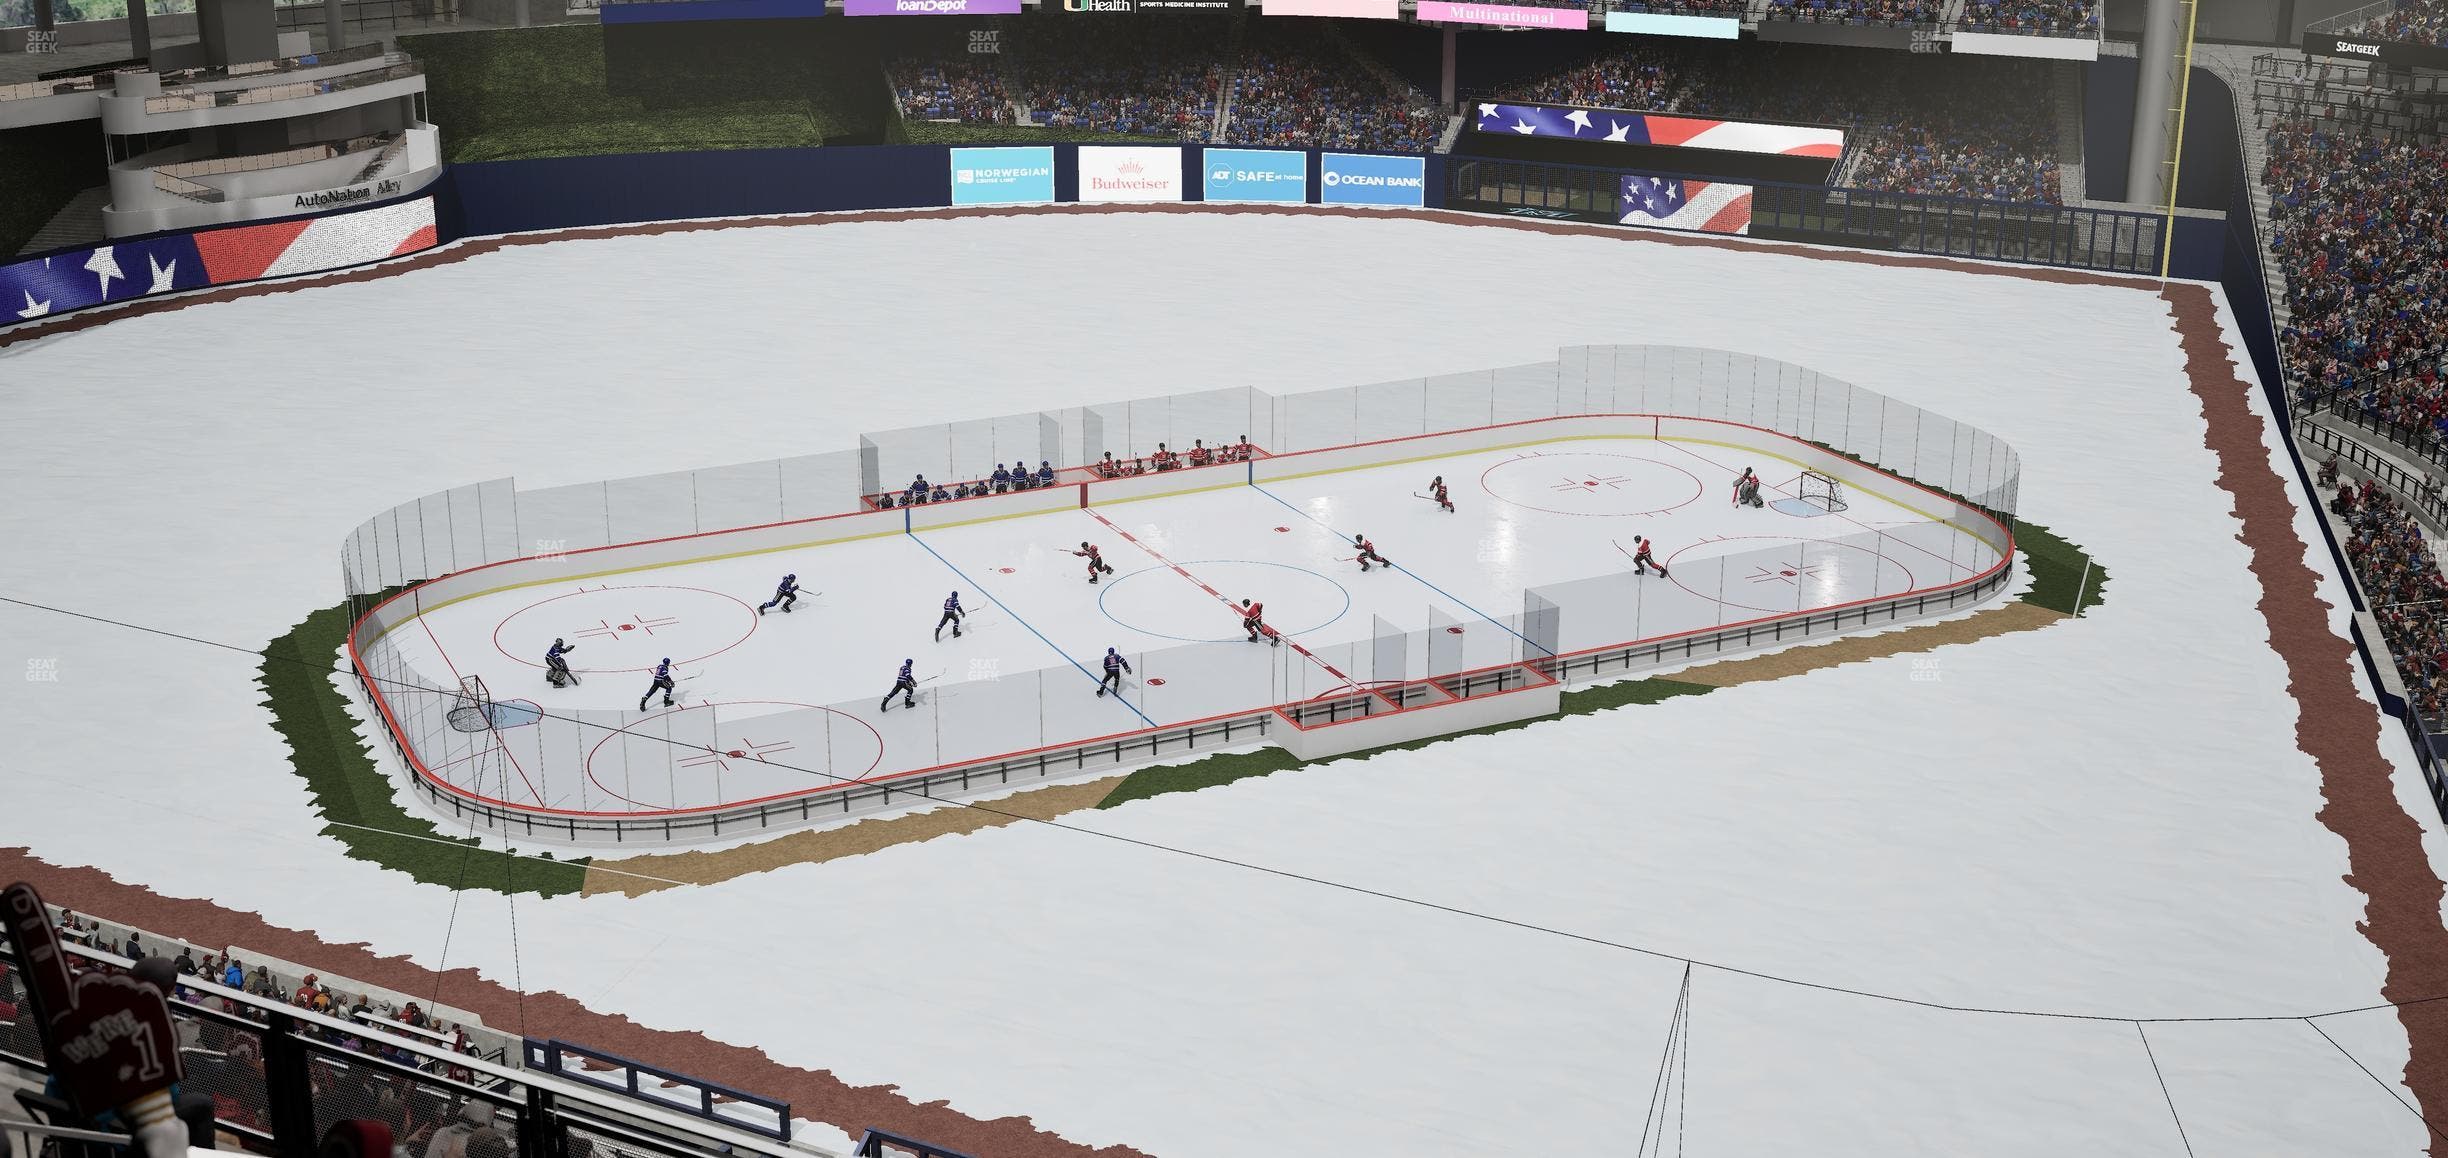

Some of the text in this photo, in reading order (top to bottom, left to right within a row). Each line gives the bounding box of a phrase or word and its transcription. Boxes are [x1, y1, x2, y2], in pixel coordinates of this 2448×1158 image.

[896, 0, 967, 12] loanDepot
[1450, 6, 1554, 25] Multinational
[2335, 41, 2380, 56] SEATGEEK
[975, 168, 1049, 178] NORWEGIAN
[1211, 171, 1231, 180] ADT
[1236, 171, 1275, 182] SAFE
[1092, 177, 1169, 190] Budweiser
[1341, 175, 1422, 188] OCEAN BANK
[295, 179, 402, 208] AutoNation Alley
